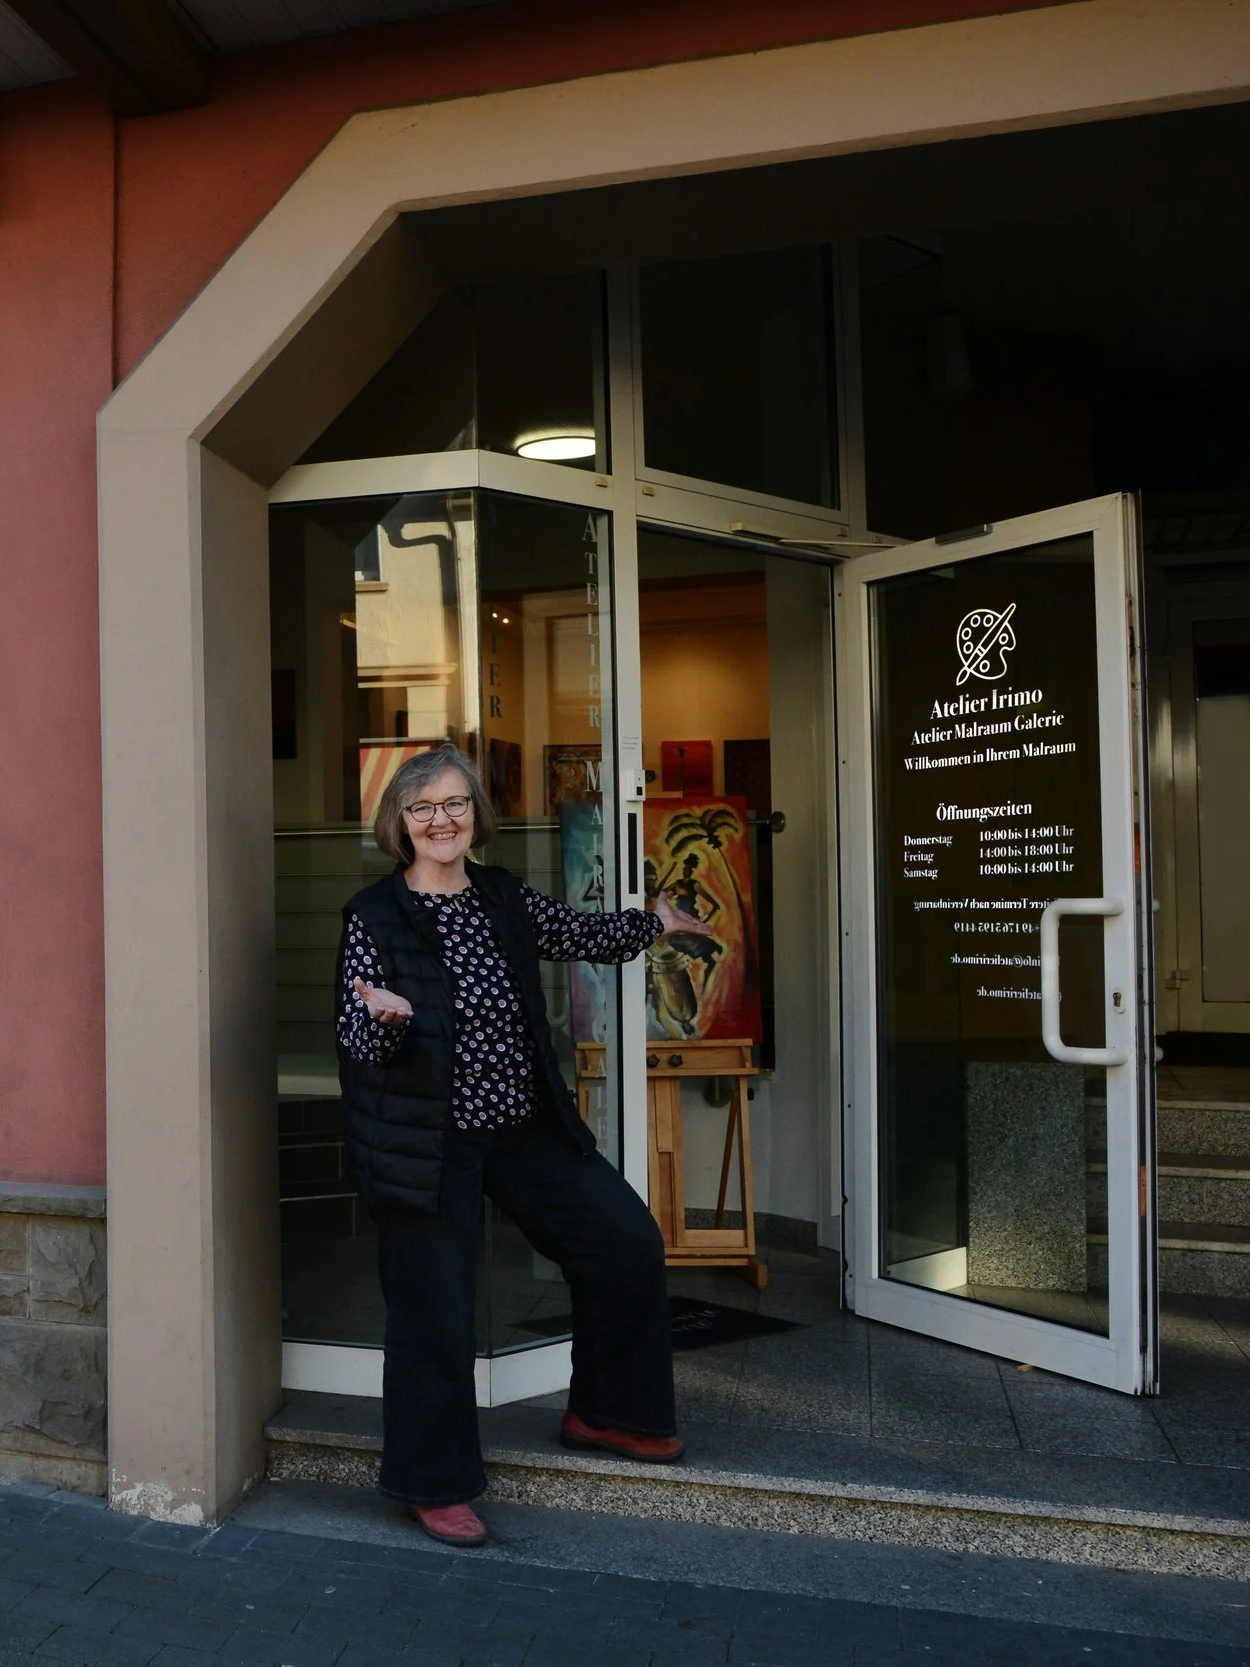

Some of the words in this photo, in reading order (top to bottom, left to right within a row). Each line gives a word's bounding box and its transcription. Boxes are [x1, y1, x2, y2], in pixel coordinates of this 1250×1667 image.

[582, 512, 600, 728] ATELIER
[930, 693, 989, 720] Atelier
[992, 686, 1043, 710] Irimo
[911, 726, 953, 746] Atelier
[954, 721, 1012, 740] Malraum
[1014, 710, 1065, 731] Galerie
[904, 754, 971, 771] Willkommen
[973, 750, 984, 763] in
[986, 747, 1021, 762] Ihrem
[1022, 742, 1076, 758] Malraum
[936, 800, 1033, 822] Öffnungszeiten
[904, 835, 953, 847] Donnerstag
[979, 830, 1007, 842] 10:00
[1008, 828, 1022, 840] bis
[1024, 826, 1053, 839] 14:00
[1055, 825, 1075, 838] Uhr
[904, 851, 934, 864] Freitag
[979, 847, 1007, 859] 14:00
[1008, 846, 1022, 858] bis
[1024, 844, 1053, 857] 18:00
[1055, 843, 1075, 855] Uhr
[903, 867, 938, 880] Samstag
[979, 863, 1007, 876] 10:00
[1008, 862, 1022, 875] bis
[1024, 861, 1053, 874] 14:00
[1055, 860, 1075, 873] Uhr
